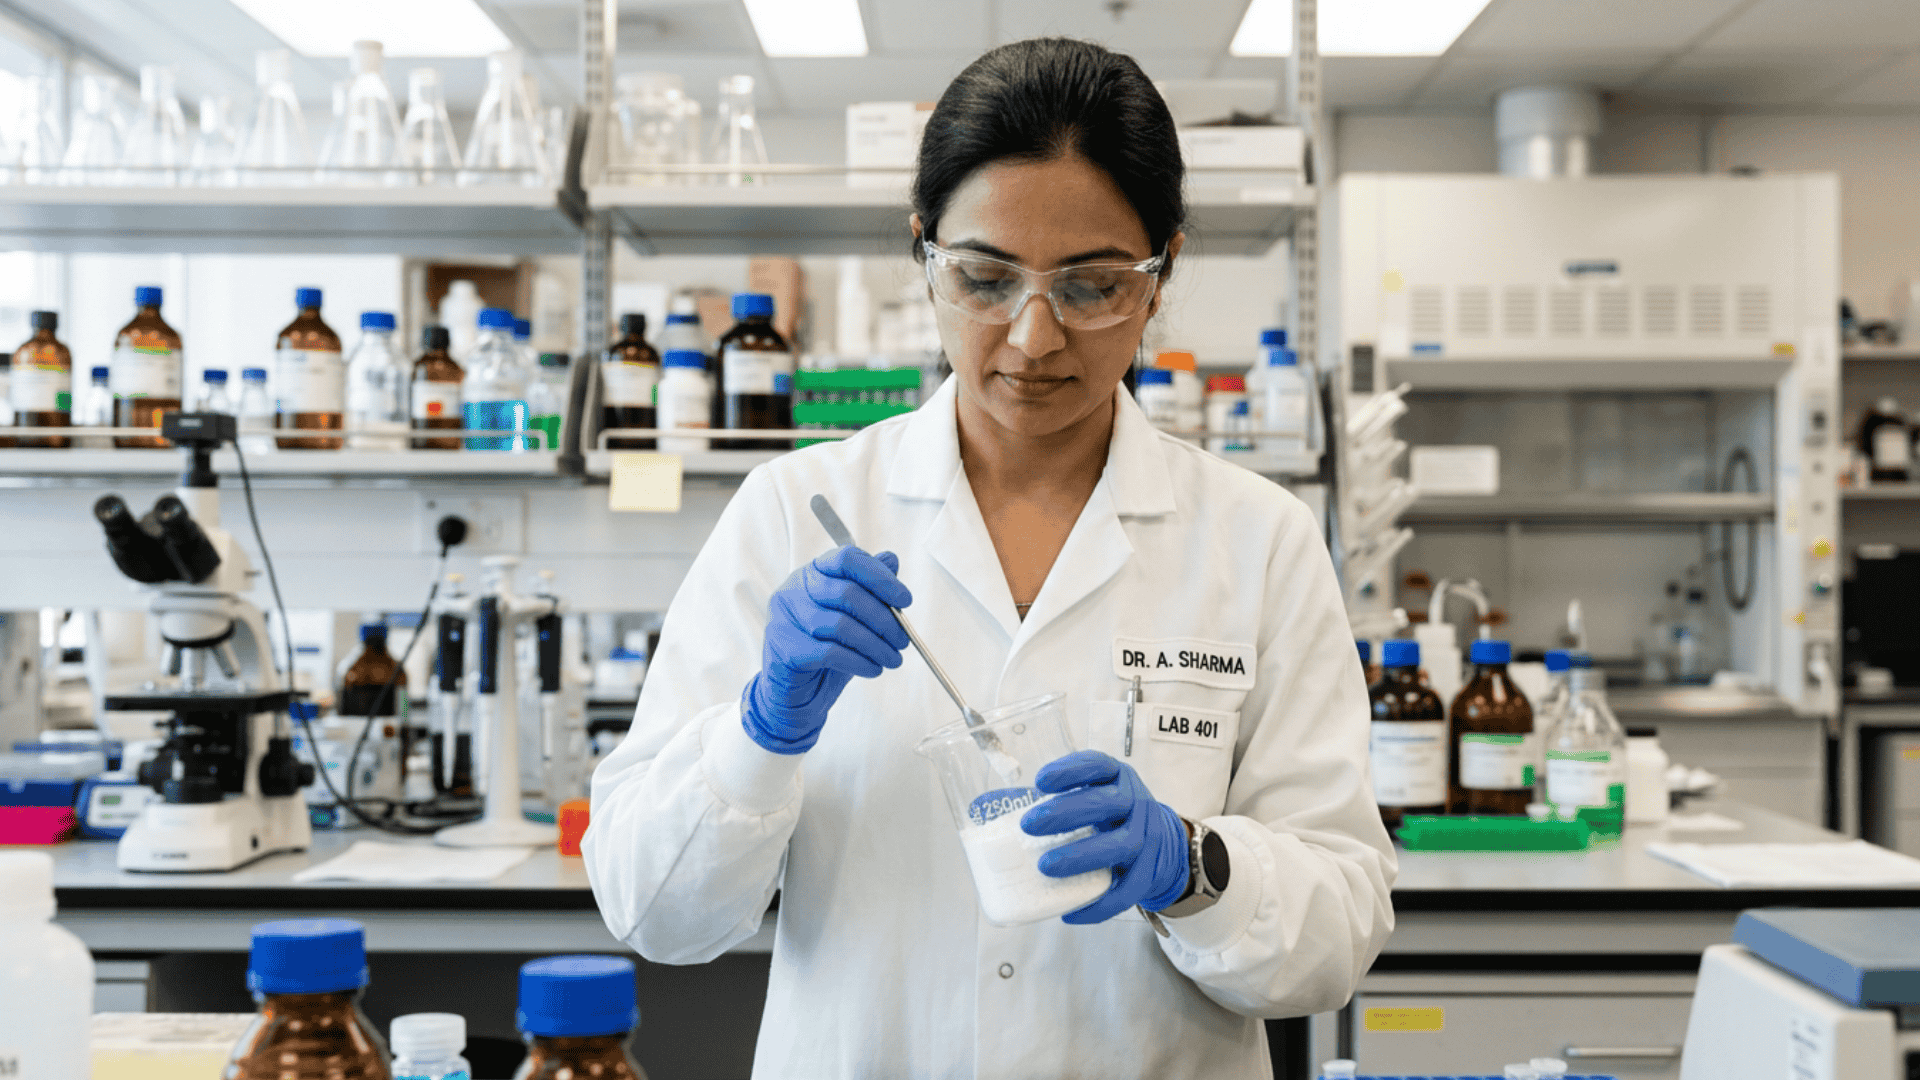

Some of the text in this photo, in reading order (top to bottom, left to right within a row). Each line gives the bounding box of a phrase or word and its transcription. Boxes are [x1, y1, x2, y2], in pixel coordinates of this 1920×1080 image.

[1122, 649, 1246, 675] DR. A. SHARMA
[1158, 714, 1218, 739] LAB 401
